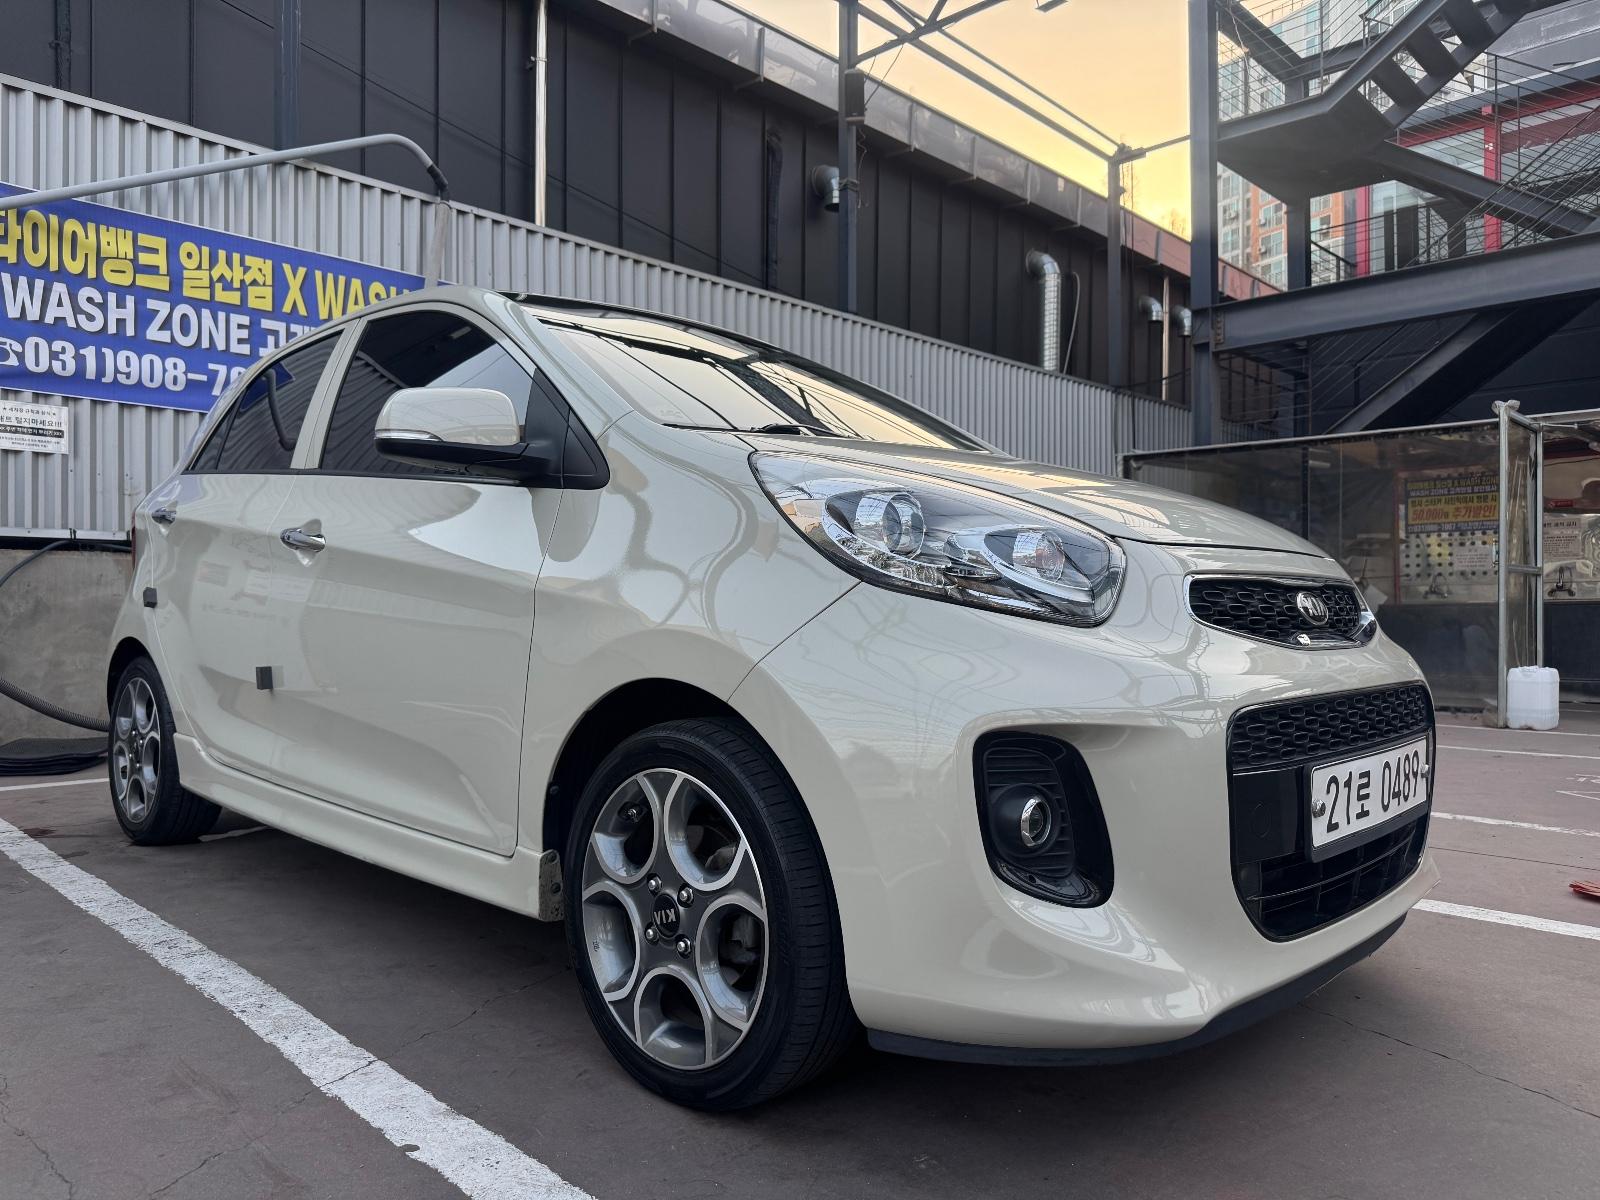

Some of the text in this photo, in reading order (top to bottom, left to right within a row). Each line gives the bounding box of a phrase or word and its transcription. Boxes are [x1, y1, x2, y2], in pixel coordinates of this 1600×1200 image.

[1, 272, 135, 337] WASH
[146, 298, 251, 356] ZONE
[179, 241, 273, 312] 일산점
[282, 263, 308, 317] X
[1326, 749, 1420, 834] 21로 0489
[653, 908, 677, 925] KIA
